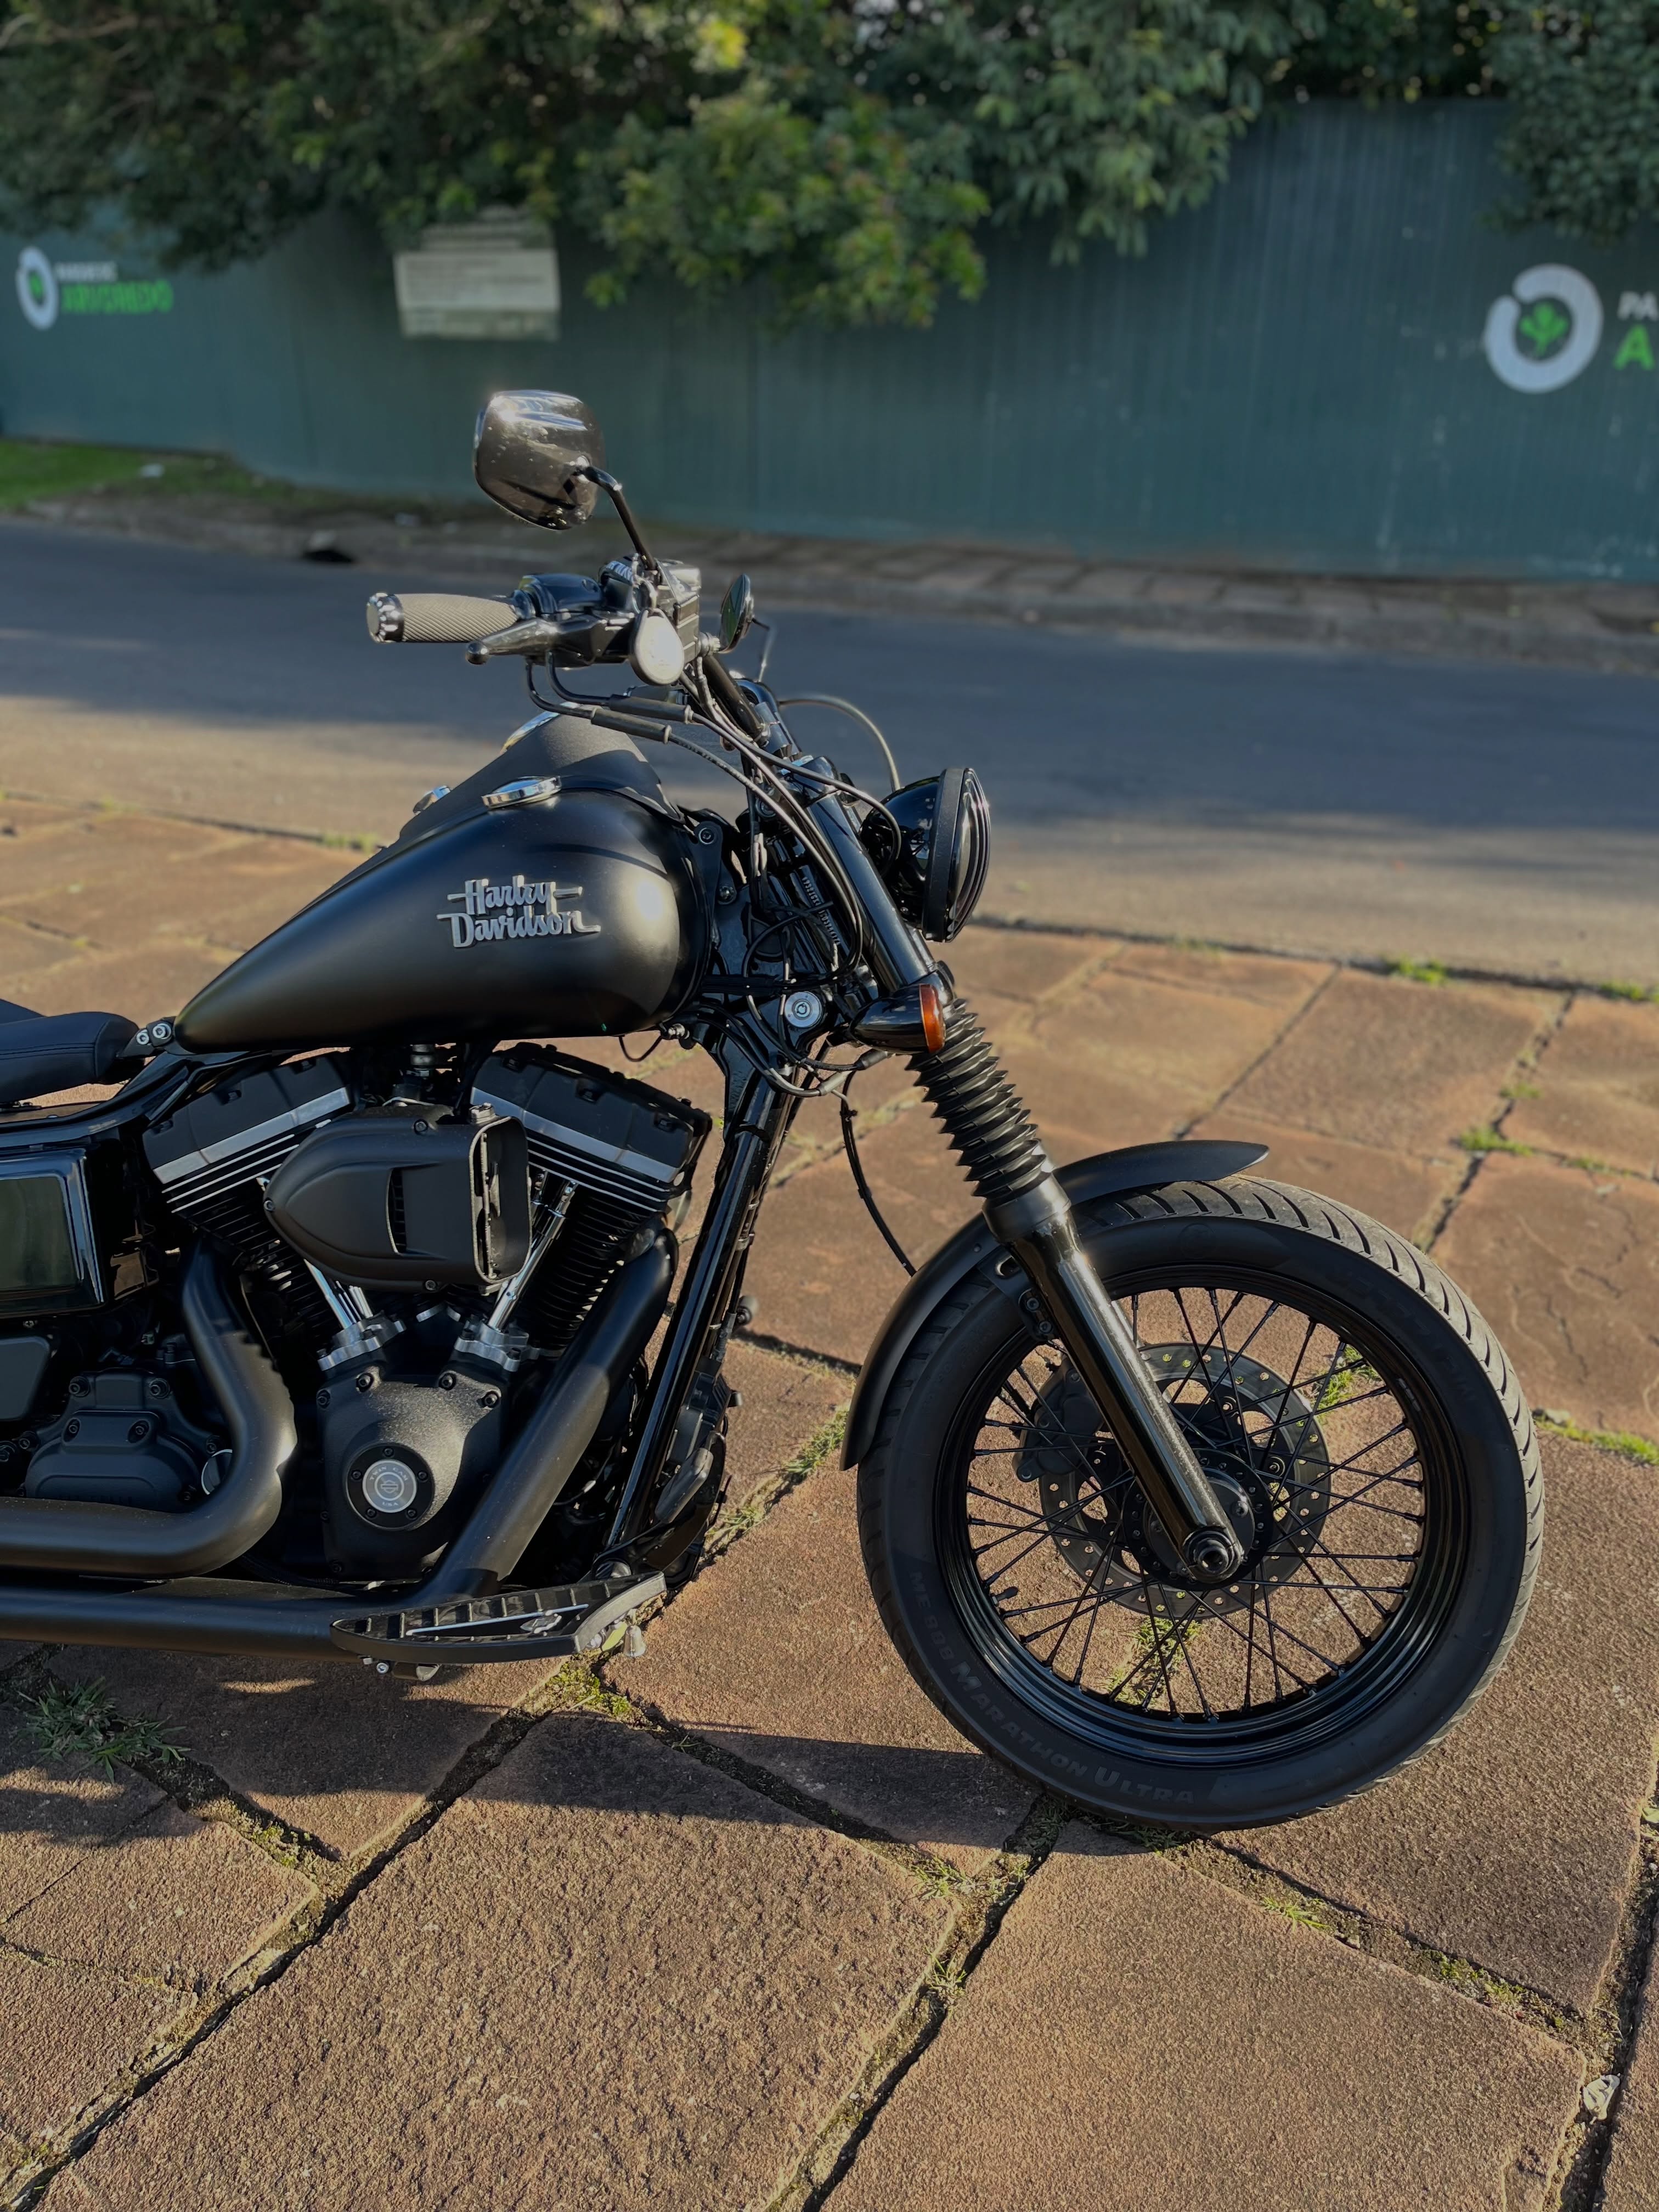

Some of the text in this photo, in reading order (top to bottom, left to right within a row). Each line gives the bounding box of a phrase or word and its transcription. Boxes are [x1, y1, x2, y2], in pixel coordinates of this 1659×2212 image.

[447, 874, 583, 916] Harley
[436, 905, 601, 948] Davidson
[369, 1466, 409, 1481] TWIN CAM
